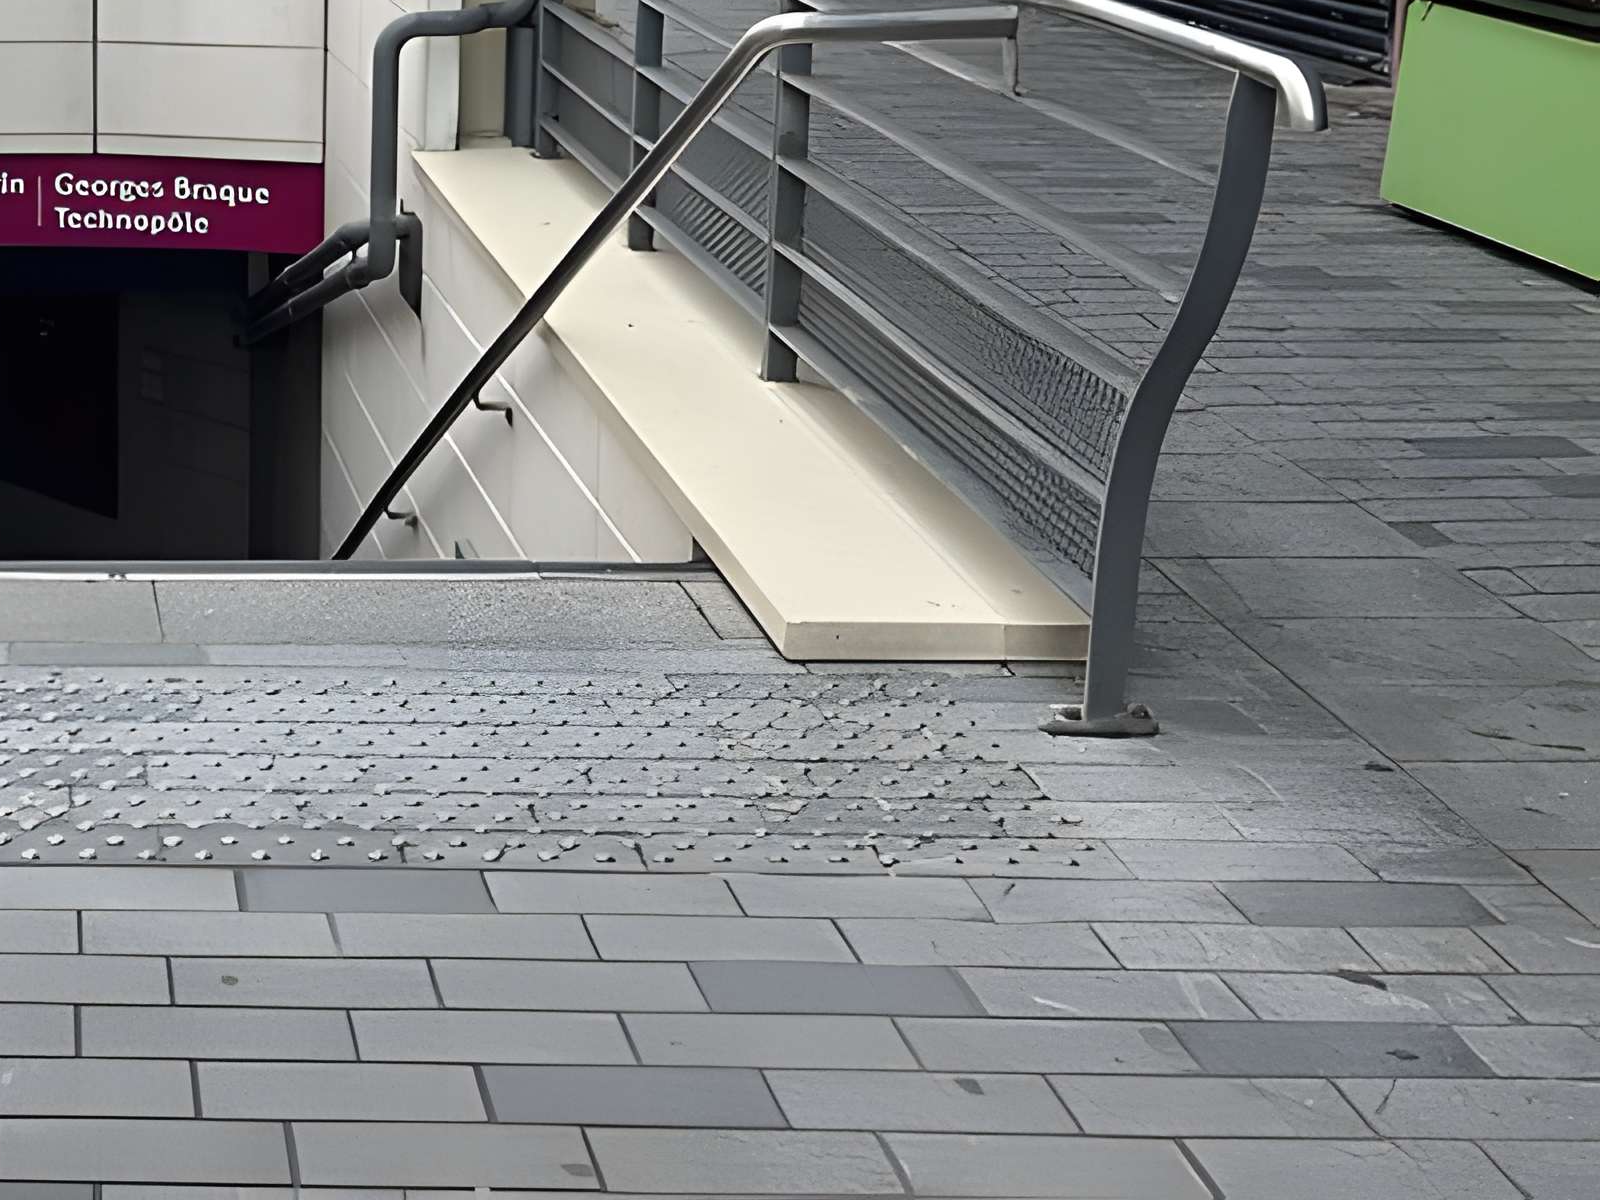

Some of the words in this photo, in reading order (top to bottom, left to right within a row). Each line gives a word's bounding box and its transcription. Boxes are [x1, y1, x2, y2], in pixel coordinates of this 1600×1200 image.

[54, 172, 164, 202] Georges
[174, 176, 270, 207] Braque
[54, 206, 209, 236] Technopôle
